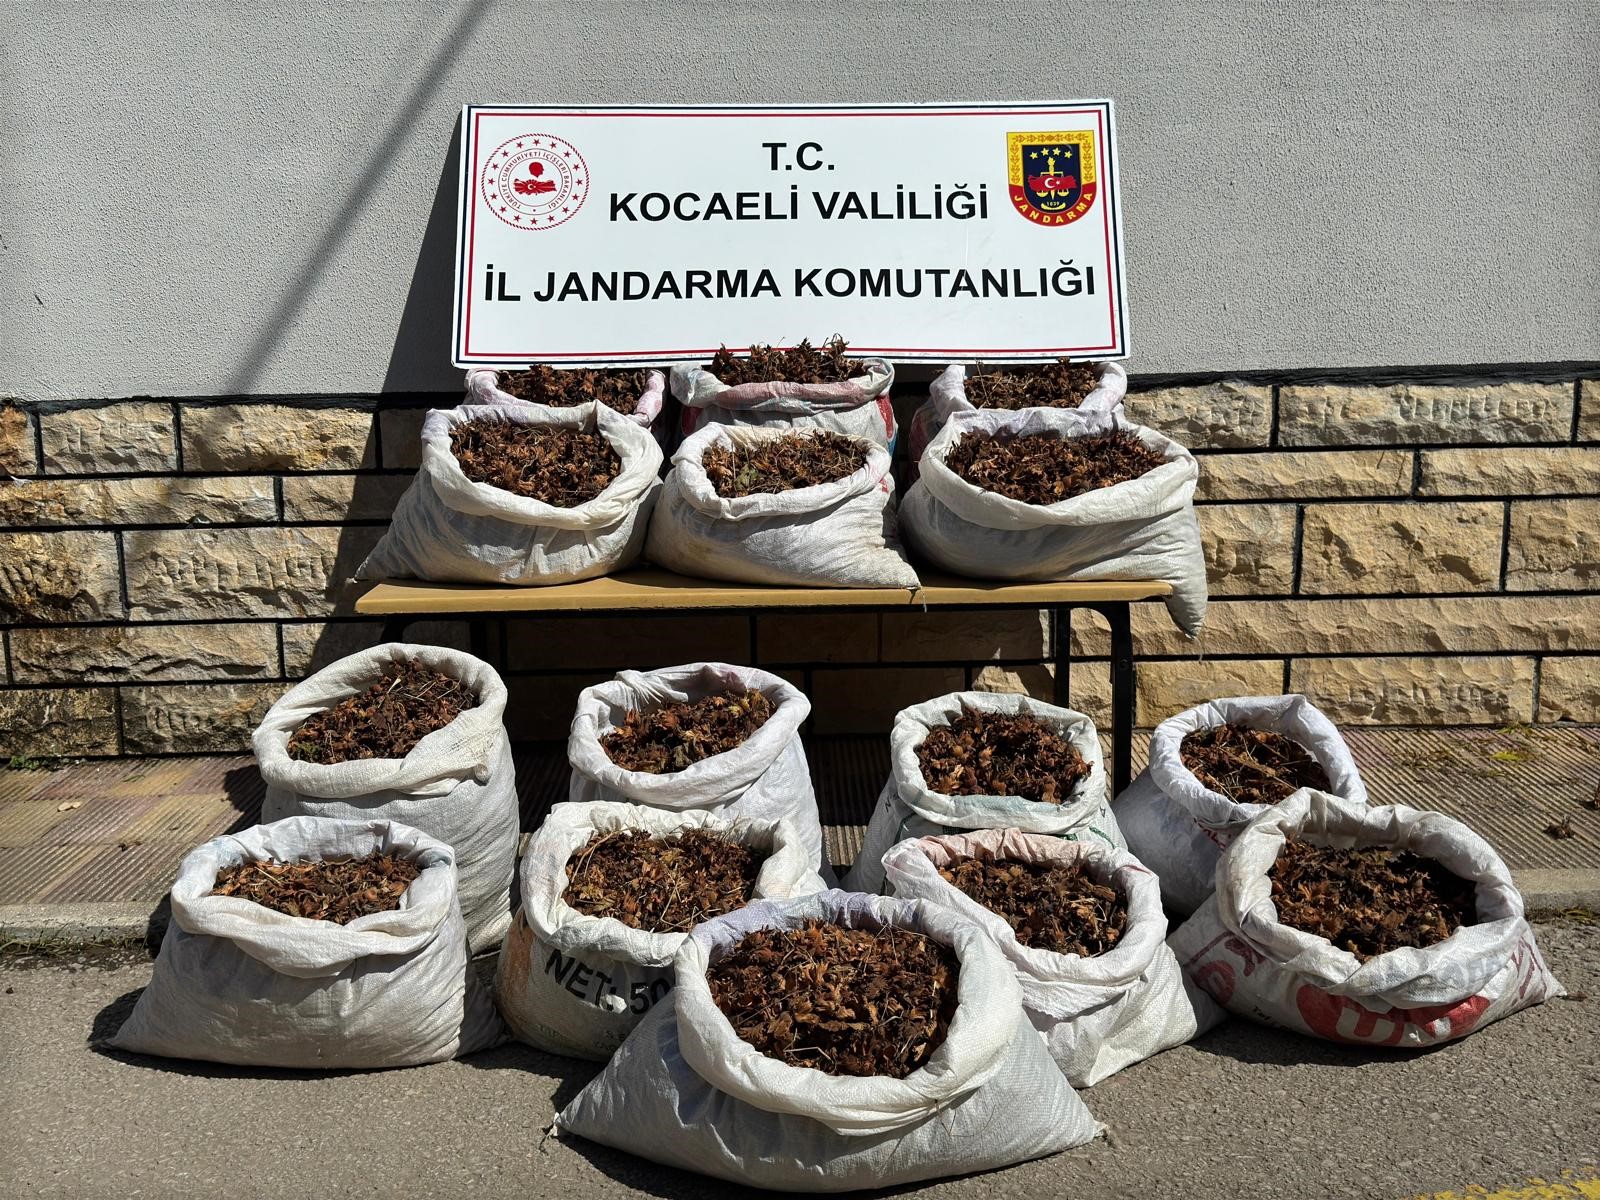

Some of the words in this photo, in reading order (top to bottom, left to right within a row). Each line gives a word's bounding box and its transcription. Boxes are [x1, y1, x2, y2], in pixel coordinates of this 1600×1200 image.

[762, 141, 835, 170] T.C.
[610, 184, 798, 221] KOCAELİ
[812, 183, 988, 220] VALİLİĞİ
[1014, 193, 1093, 224] JANDARMA
[485, 263, 521, 301] İL
[533, 267, 782, 302] JANDARMA
[794, 259, 1095, 298] KOMUTANLIĞI
